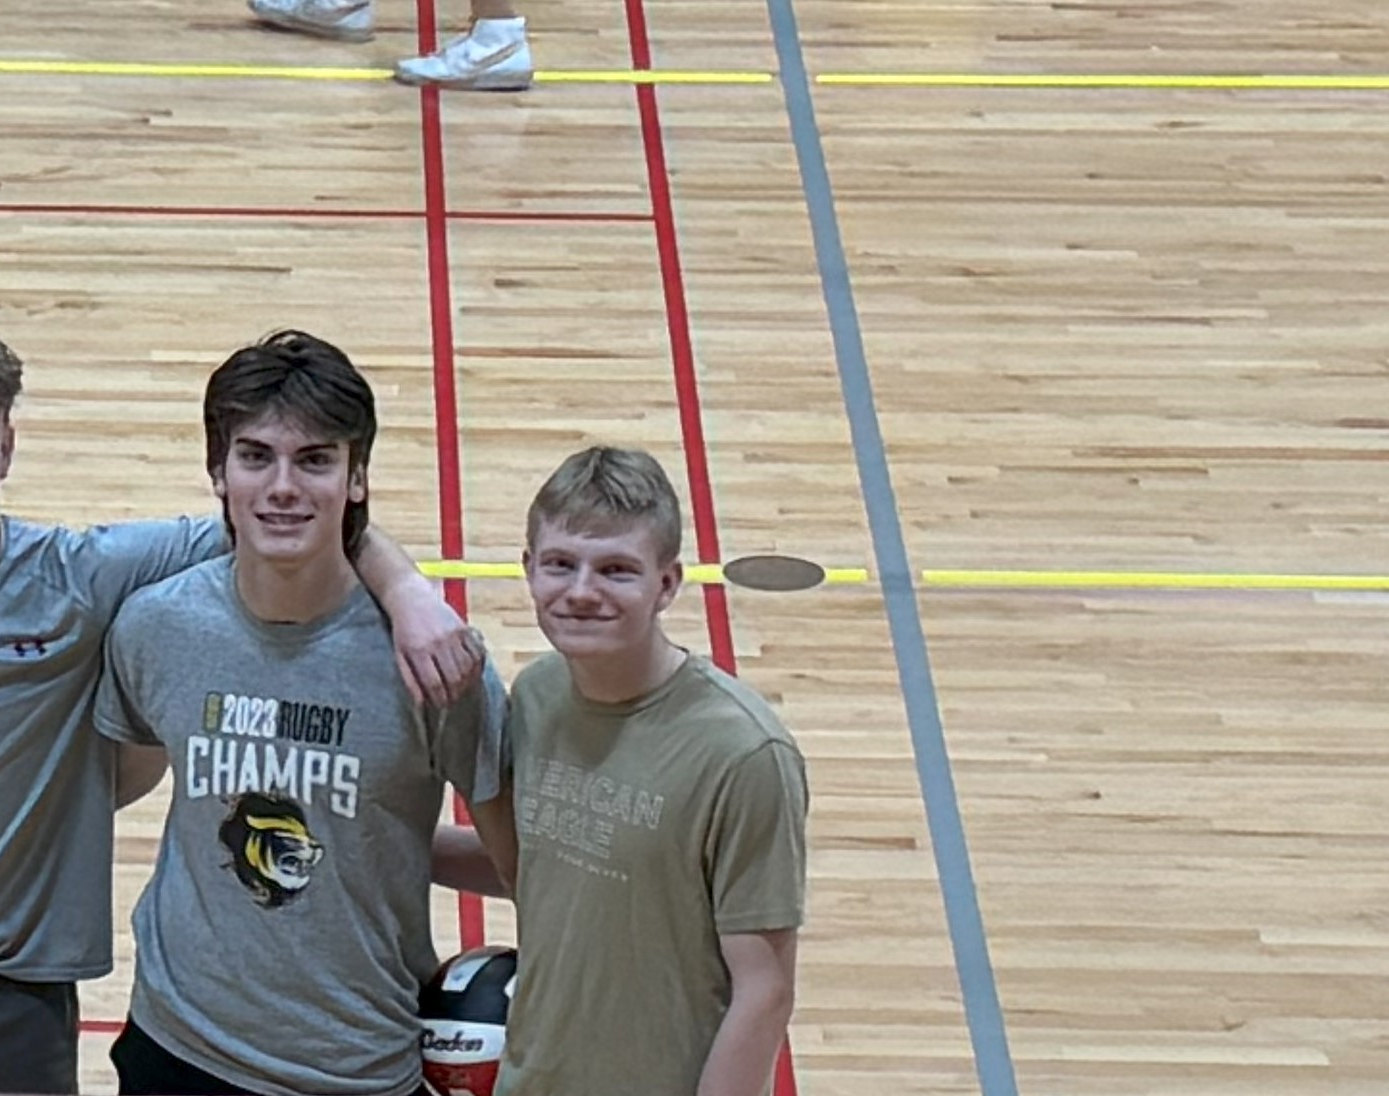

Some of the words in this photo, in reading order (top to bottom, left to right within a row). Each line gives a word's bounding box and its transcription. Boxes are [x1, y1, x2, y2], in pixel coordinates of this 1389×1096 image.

[222, 694, 278, 738] 2023
[278, 701, 351, 746] RUGBY
[187, 736, 360, 819] CHAMPS
